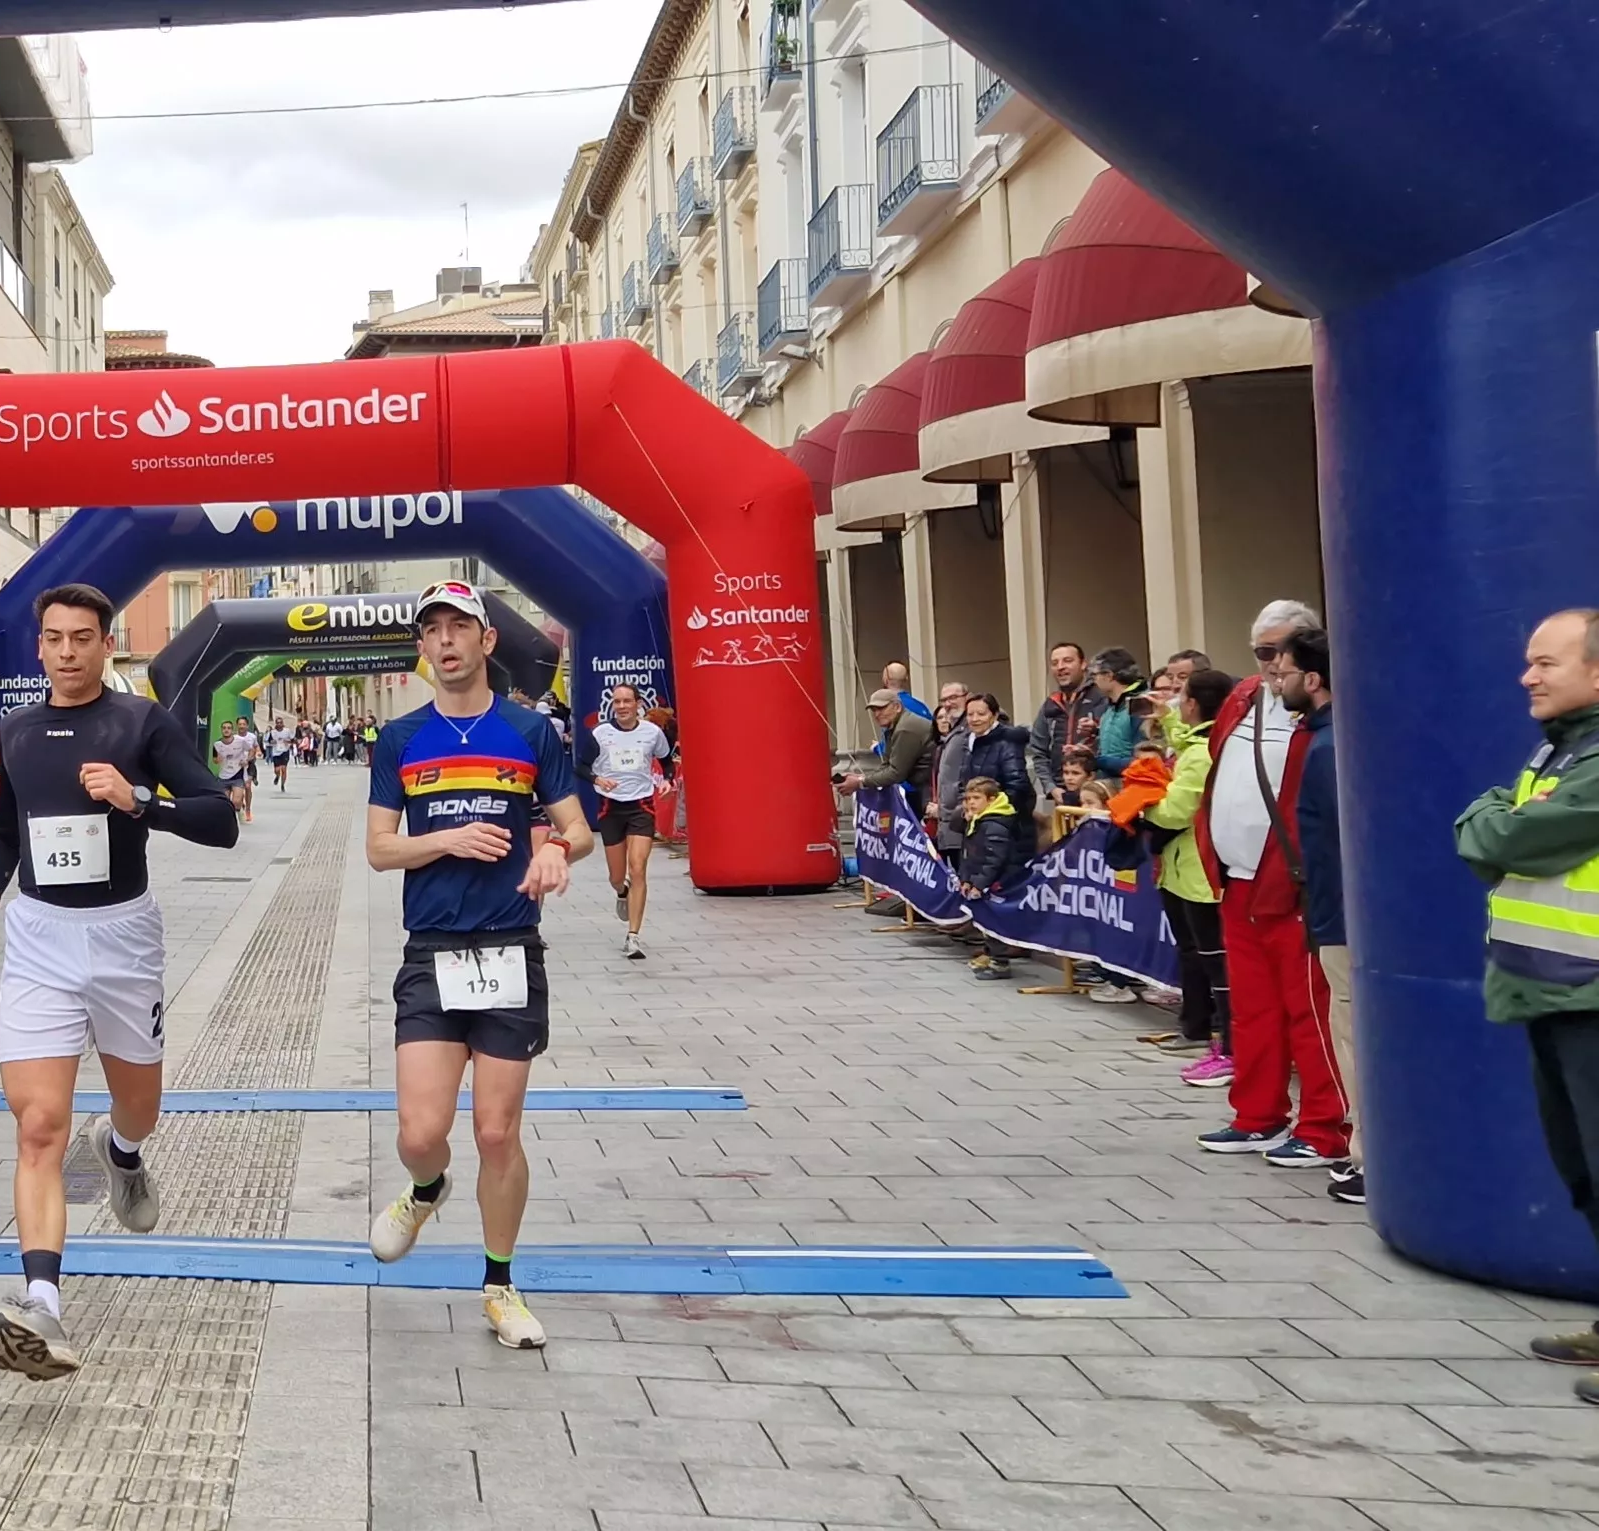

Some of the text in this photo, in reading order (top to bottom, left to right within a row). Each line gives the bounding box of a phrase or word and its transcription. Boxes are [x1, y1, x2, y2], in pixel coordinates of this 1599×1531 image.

[198, 387, 427, 434] Santander
[131, 451, 274, 473] sportssantander.es
[296, 490, 463, 539] mupol
[714, 571, 782, 596] Sports
[287, 598, 413, 631] embou
[710, 604, 810, 627] Santander
[305, 665, 326, 673] CAJA
[329, 663, 355, 671] RURAL
[357, 662, 369, 670] DE
[591, 655, 665, 671] fundación
[604, 671, 652, 687] mupol
[2, 689, 46, 704] mupol
[413, 766, 442, 788] 13
[454, 814, 483, 823] SPORTS
[47, 851, 82, 868] 435
[1018, 883, 1134, 933] NACIONAL
[466, 979, 499, 994] 179
